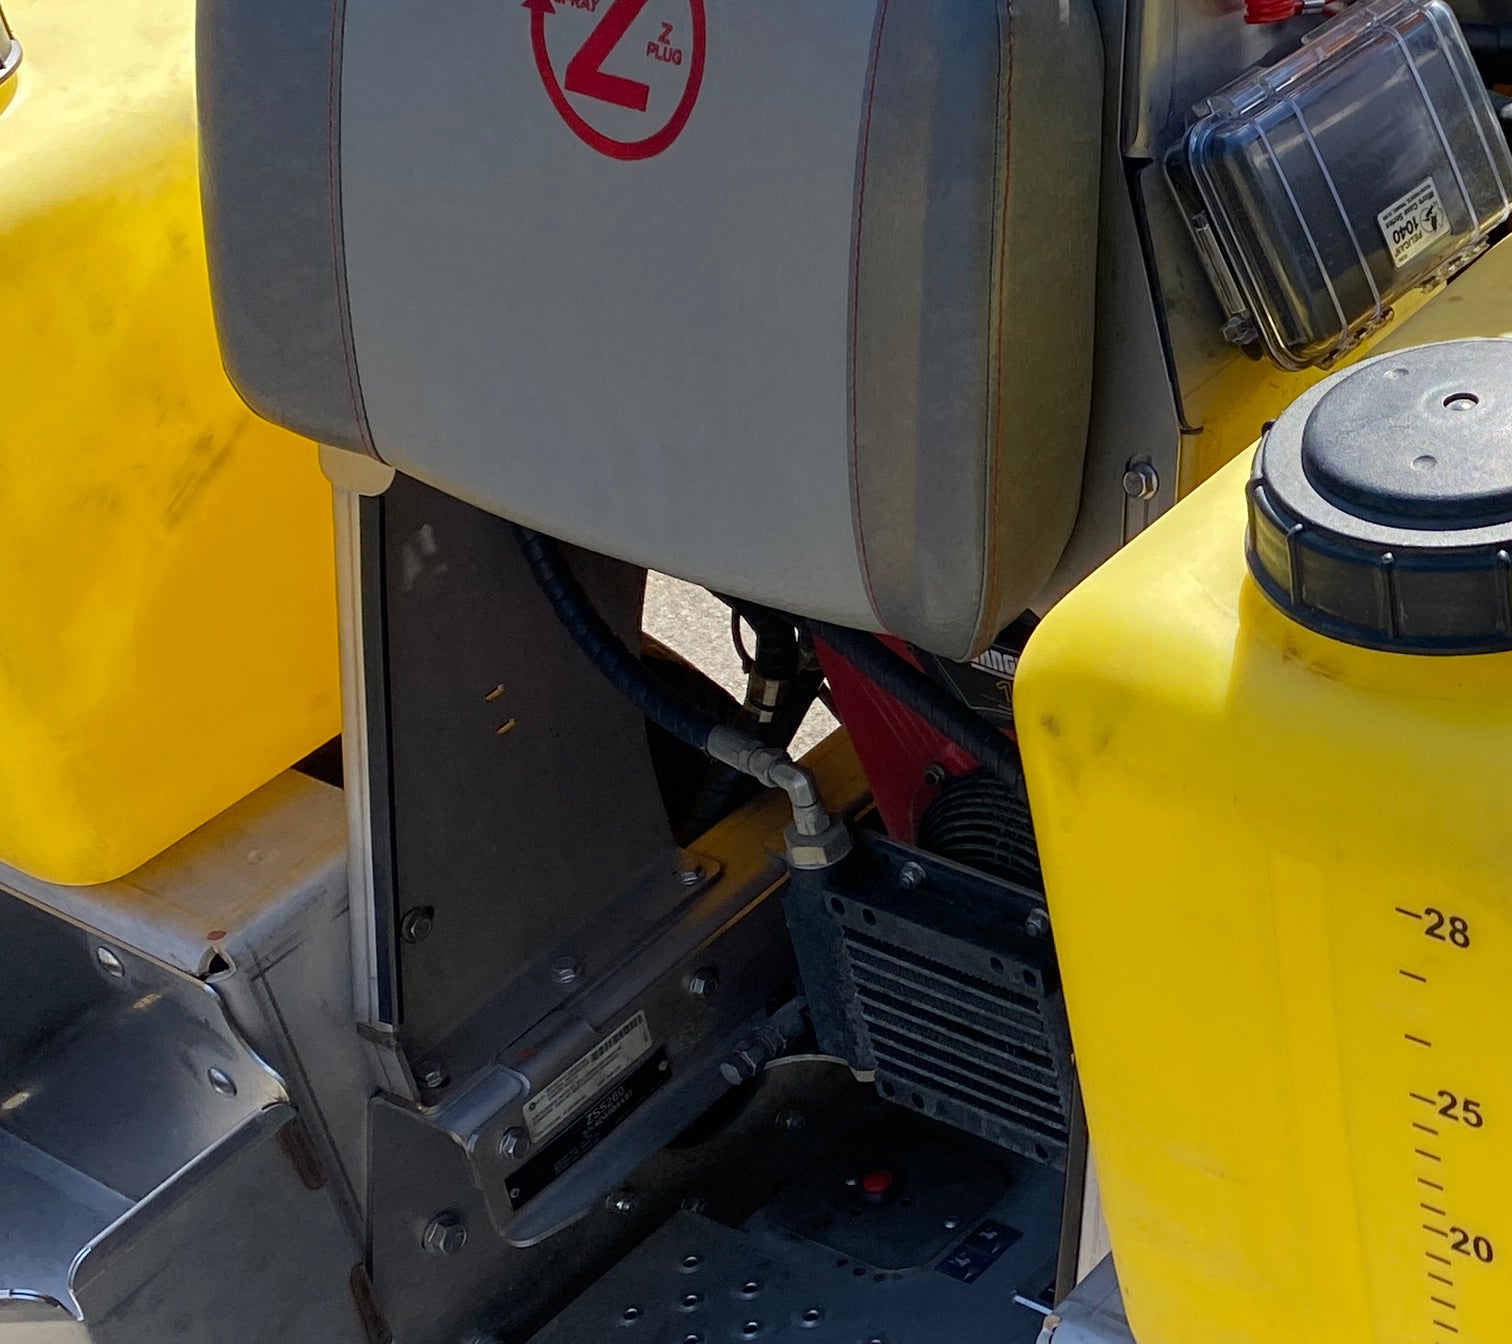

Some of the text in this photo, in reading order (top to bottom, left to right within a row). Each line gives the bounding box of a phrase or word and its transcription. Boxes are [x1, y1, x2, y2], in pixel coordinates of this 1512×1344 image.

[657, 22, 674, 45] Z
[646, 41, 683, 66] PLUG
[1385, 190, 1435, 229] Micro Case Series
[1392, 216, 1419, 244] 1040
[1394, 230, 1423, 257] PELICAN
[1423, 907, 1472, 949] 28
[1437, 1089, 1484, 1129] 25
[1449, 1226, 1494, 1264] 20
